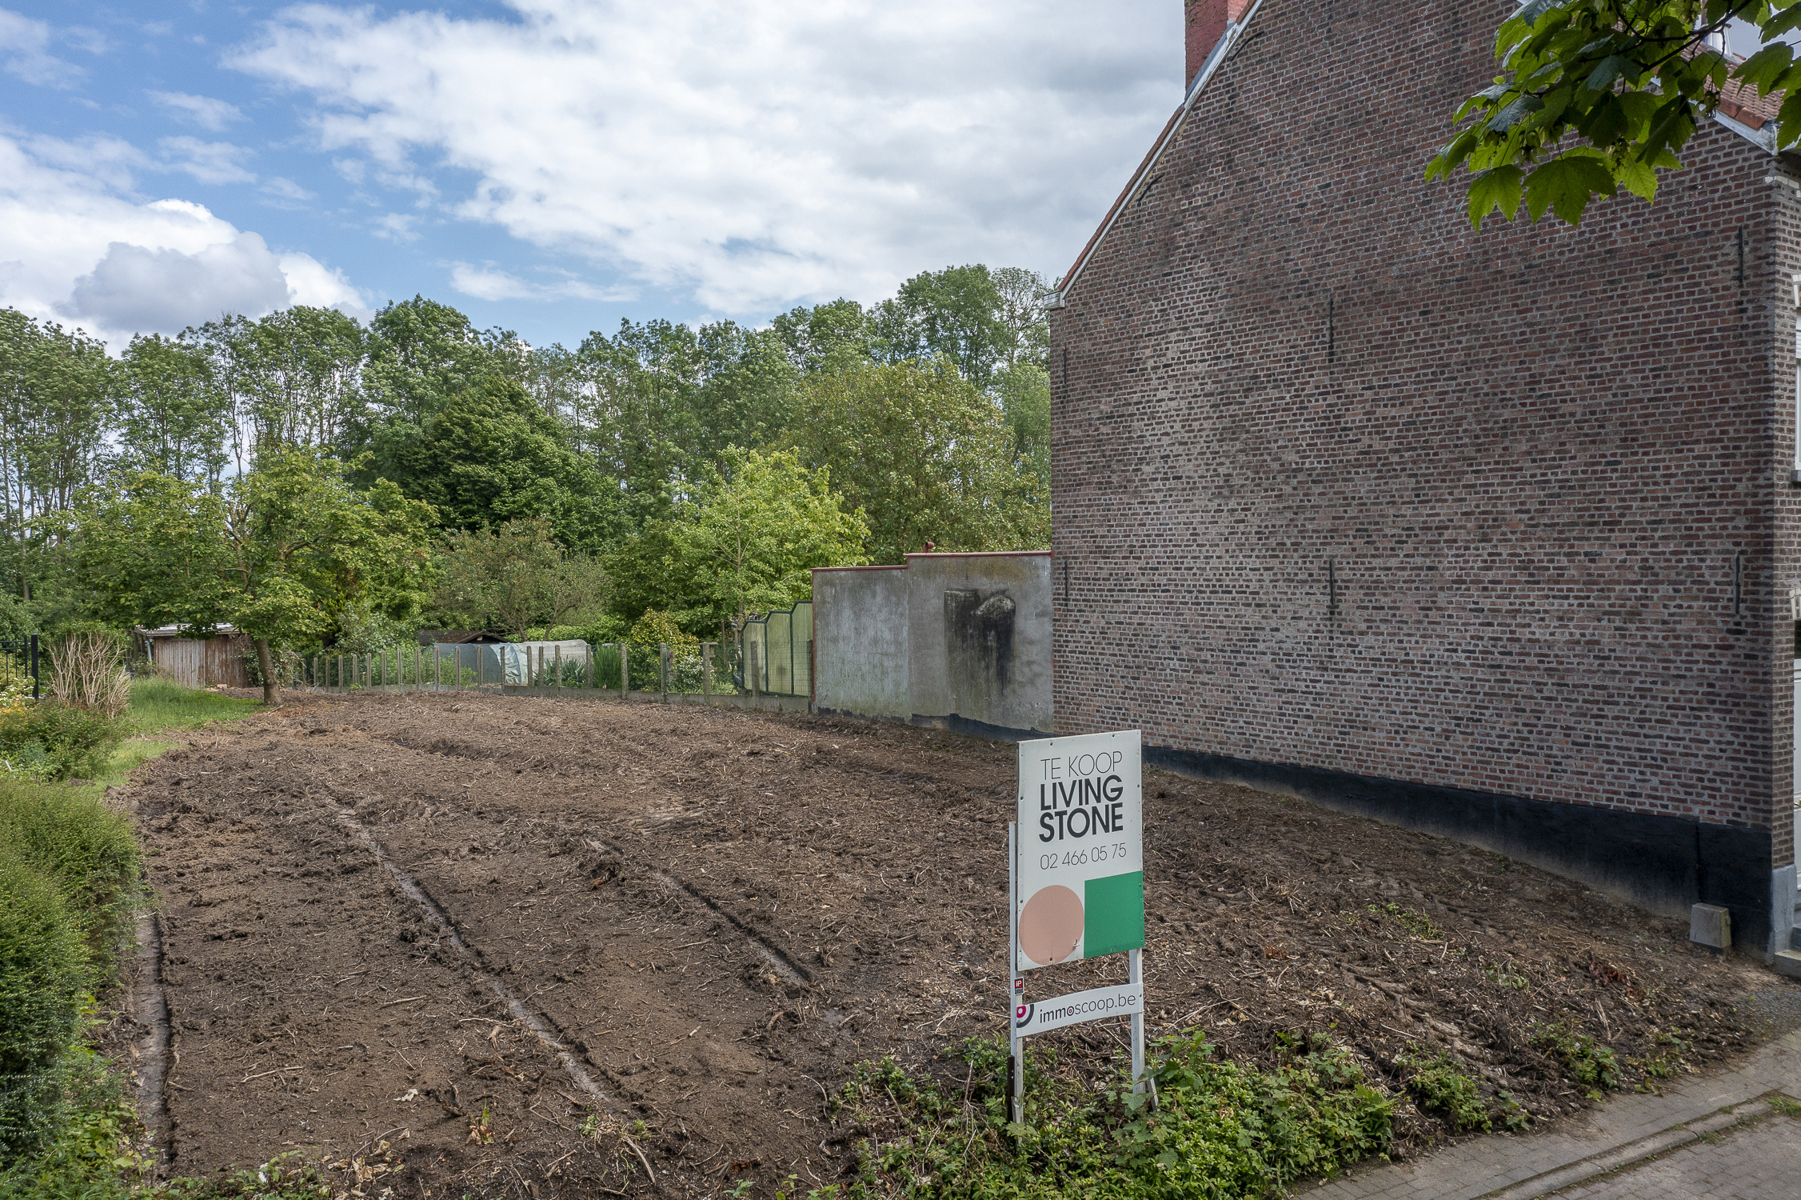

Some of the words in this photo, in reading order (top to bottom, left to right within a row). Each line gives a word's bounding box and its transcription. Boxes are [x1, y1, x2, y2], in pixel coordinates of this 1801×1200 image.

[1040, 757, 1061, 780] TE
[1068, 751, 1122, 777] KOOP
[1041, 775, 1123, 811] LIVING
[1039, 802, 1123, 842] STONE
[1040, 853, 1058, 870] 02
[1062, 849, 1088, 866] 466
[1091, 846, 1108, 862] 05
[1112, 843, 1126, 858] 75
[1040, 994, 1136, 1024] immoscoop.be
